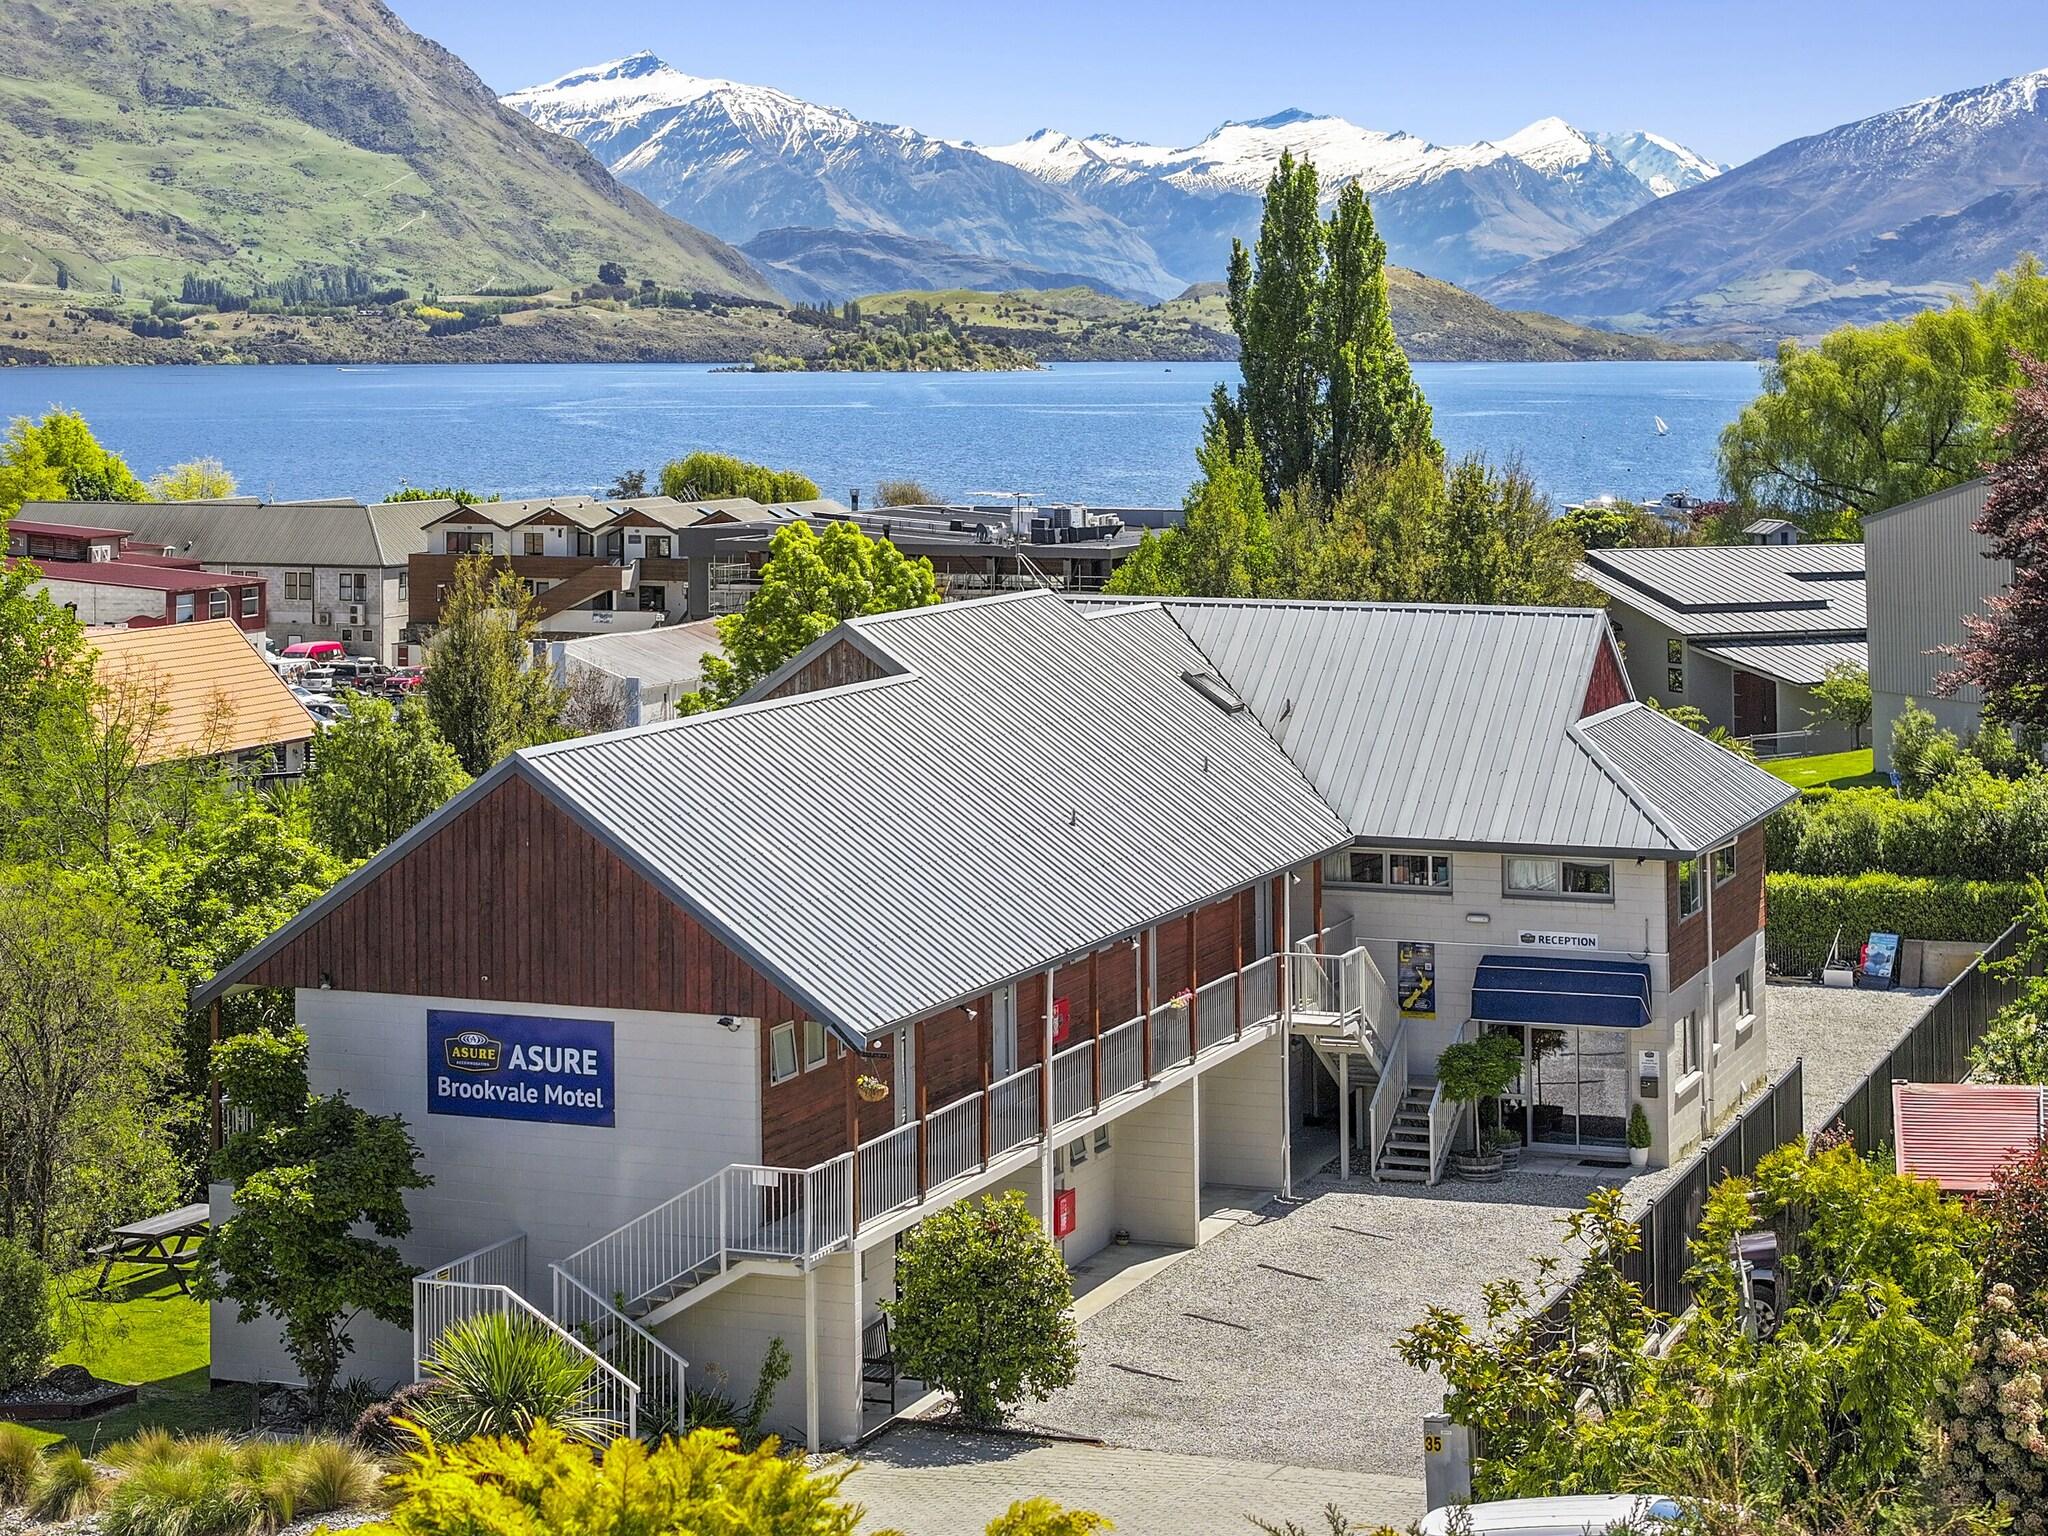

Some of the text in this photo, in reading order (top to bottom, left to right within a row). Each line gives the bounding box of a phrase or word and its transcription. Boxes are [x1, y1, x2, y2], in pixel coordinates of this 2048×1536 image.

[1538, 935, 1596, 947] RECEPTION
[452, 1046, 496, 1060] ASURE
[508, 1044, 598, 1076] ASURE
[437, 1076, 604, 1109] Brookvale Motel
[1425, 1436, 1442, 1452] 35
